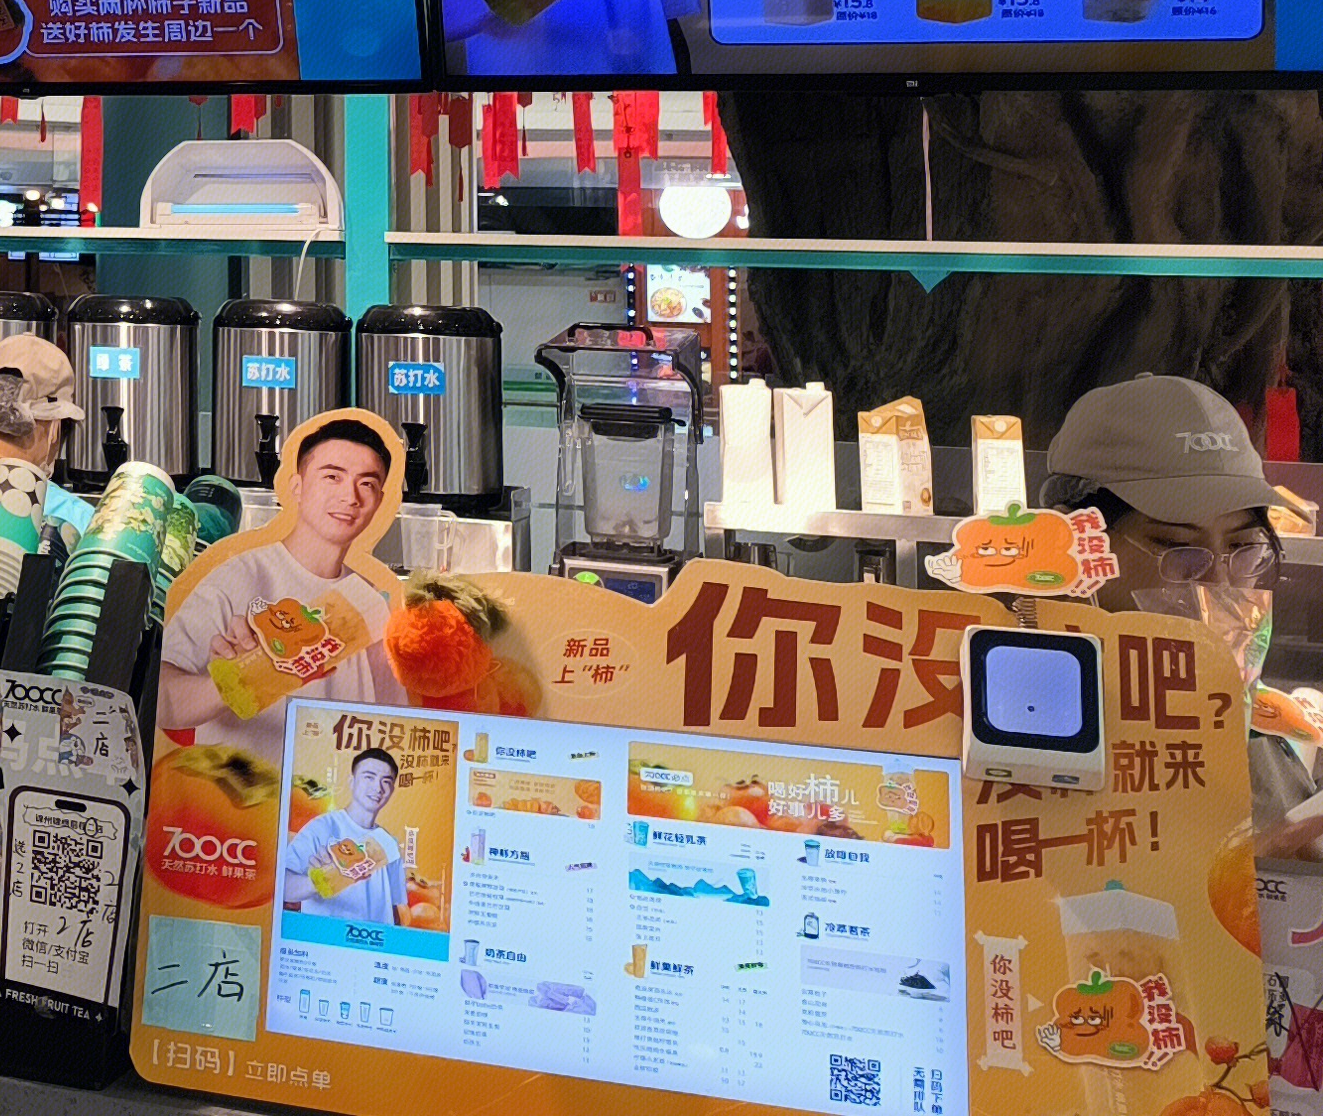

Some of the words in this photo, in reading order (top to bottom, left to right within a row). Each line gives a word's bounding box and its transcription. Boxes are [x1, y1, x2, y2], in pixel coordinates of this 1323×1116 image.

[40, 16, 264, 45] 送好柿发生周边一个
[245, 361, 291, 385] 苏打水
[393, 366, 440, 389] 苏打水
[563, 637, 611, 659] 新品
[666, 582, 1235, 730] 你没吧?
[162, 826, 258, 866] 700CC
[976, 808, 1159, 883] 喝一杯!
[161, 858, 219, 879] 天然苏打水
[221, 864, 257, 882] 鲜果茶
[23, 920, 49, 936] 打开
[21, 954, 59, 975] 扫一扫
[22, 937, 90, 965] 微信/支付宝
[151, 950, 245, 1004] 二店
[5, 987, 40, 1006] FRESH
[72, 1004, 91, 1021] TEA
[990, 953, 1017, 1052] 你没柿吧
